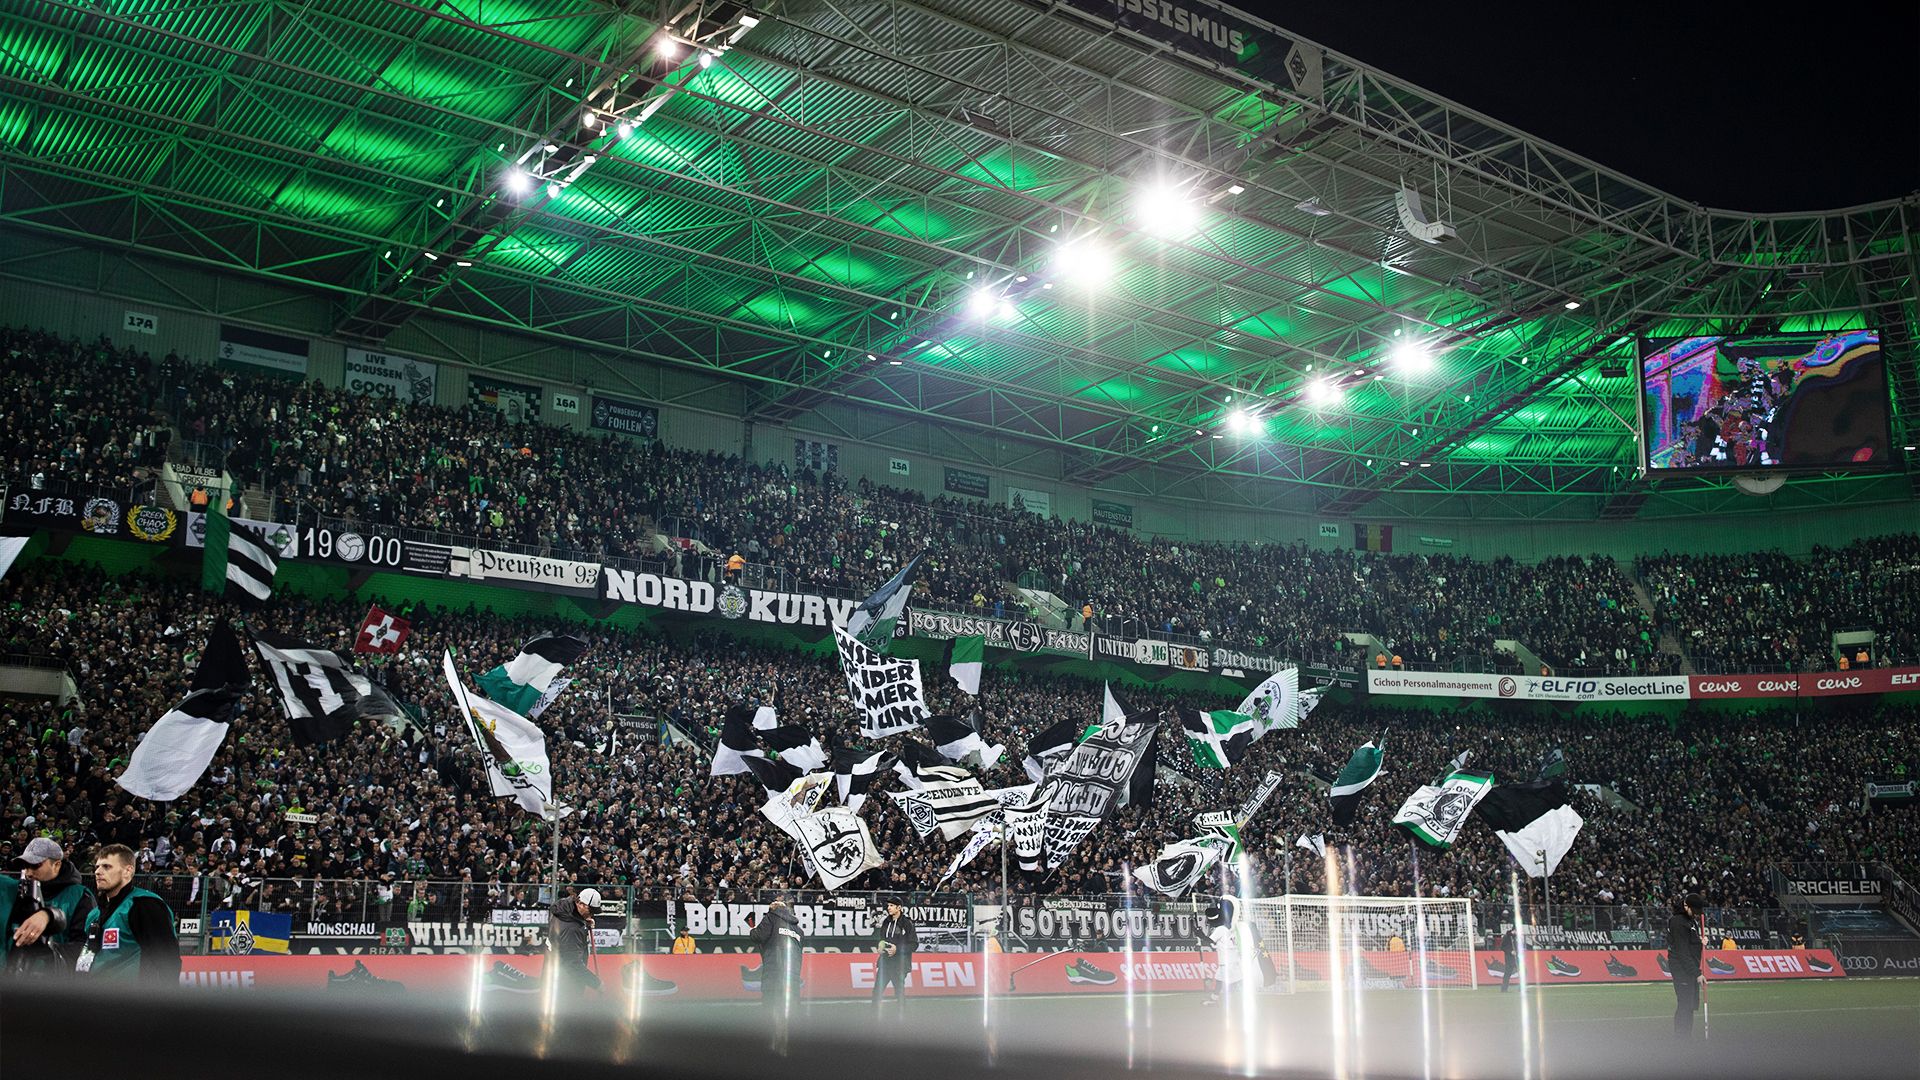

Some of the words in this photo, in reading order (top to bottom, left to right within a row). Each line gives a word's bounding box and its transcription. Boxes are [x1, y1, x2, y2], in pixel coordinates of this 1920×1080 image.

[127, 316, 153, 329] 17A
[366, 354, 386, 365] LIVE
[347, 362, 402, 380] BORUSSEN
[351, 379, 396, 395] GOCH
[556, 397, 577, 409] 16A
[608, 416, 642, 432] FOHLEN
[176, 463, 191, 472] BAD
[193, 467, 217, 477] VILBEL
[892, 461, 907, 471] 15A
[185, 486, 220, 496] BOSSIA
[139, 510, 165, 520] GREEN
[136, 518, 166, 529] CHAOS
[1321, 525, 1337, 534] 14A
[304, 528, 332, 558] 19
[368, 536, 401, 566] 00
[472, 549, 564, 579] Preußen
[604, 567, 714, 613] NORD
[749, 589, 860, 627] KURV
[911, 613, 1002, 640] BORUSSIA
[1046, 629, 1089, 651] FANS
[1097, 637, 1136, 659] UNITED
[1151, 645, 1167, 661] MG
[1170, 648, 1184, 666] RG
[1194, 650, 1209, 668] MG
[1211, 648, 1297, 673] Niederrhein
[1373, 678, 1401, 687] Cichon
[1403, 679, 1493, 691] Personalmanagement
[1605, 682, 1685, 696] SelectLine
[1699, 681, 1742, 693] cewe
[1757, 680, 1797, 692] cewe
[1816, 677, 1863, 690] cewe
[926, 786, 981, 800] CENDENTE
[1788, 881, 1881, 894] BRACHELEN
[684, 900, 876, 937] BÖKBERG
[901, 906, 967, 923] RONTLINE
[182, 921, 198, 930] 17/1
[307, 922, 376, 935] MONSCHAU
[407, 921, 542, 947] WILLICHER
[1742, 955, 1804, 973] ELTEN
[1883, 957, 1920, 969] Audi
[850, 961, 977, 989] ETEN
